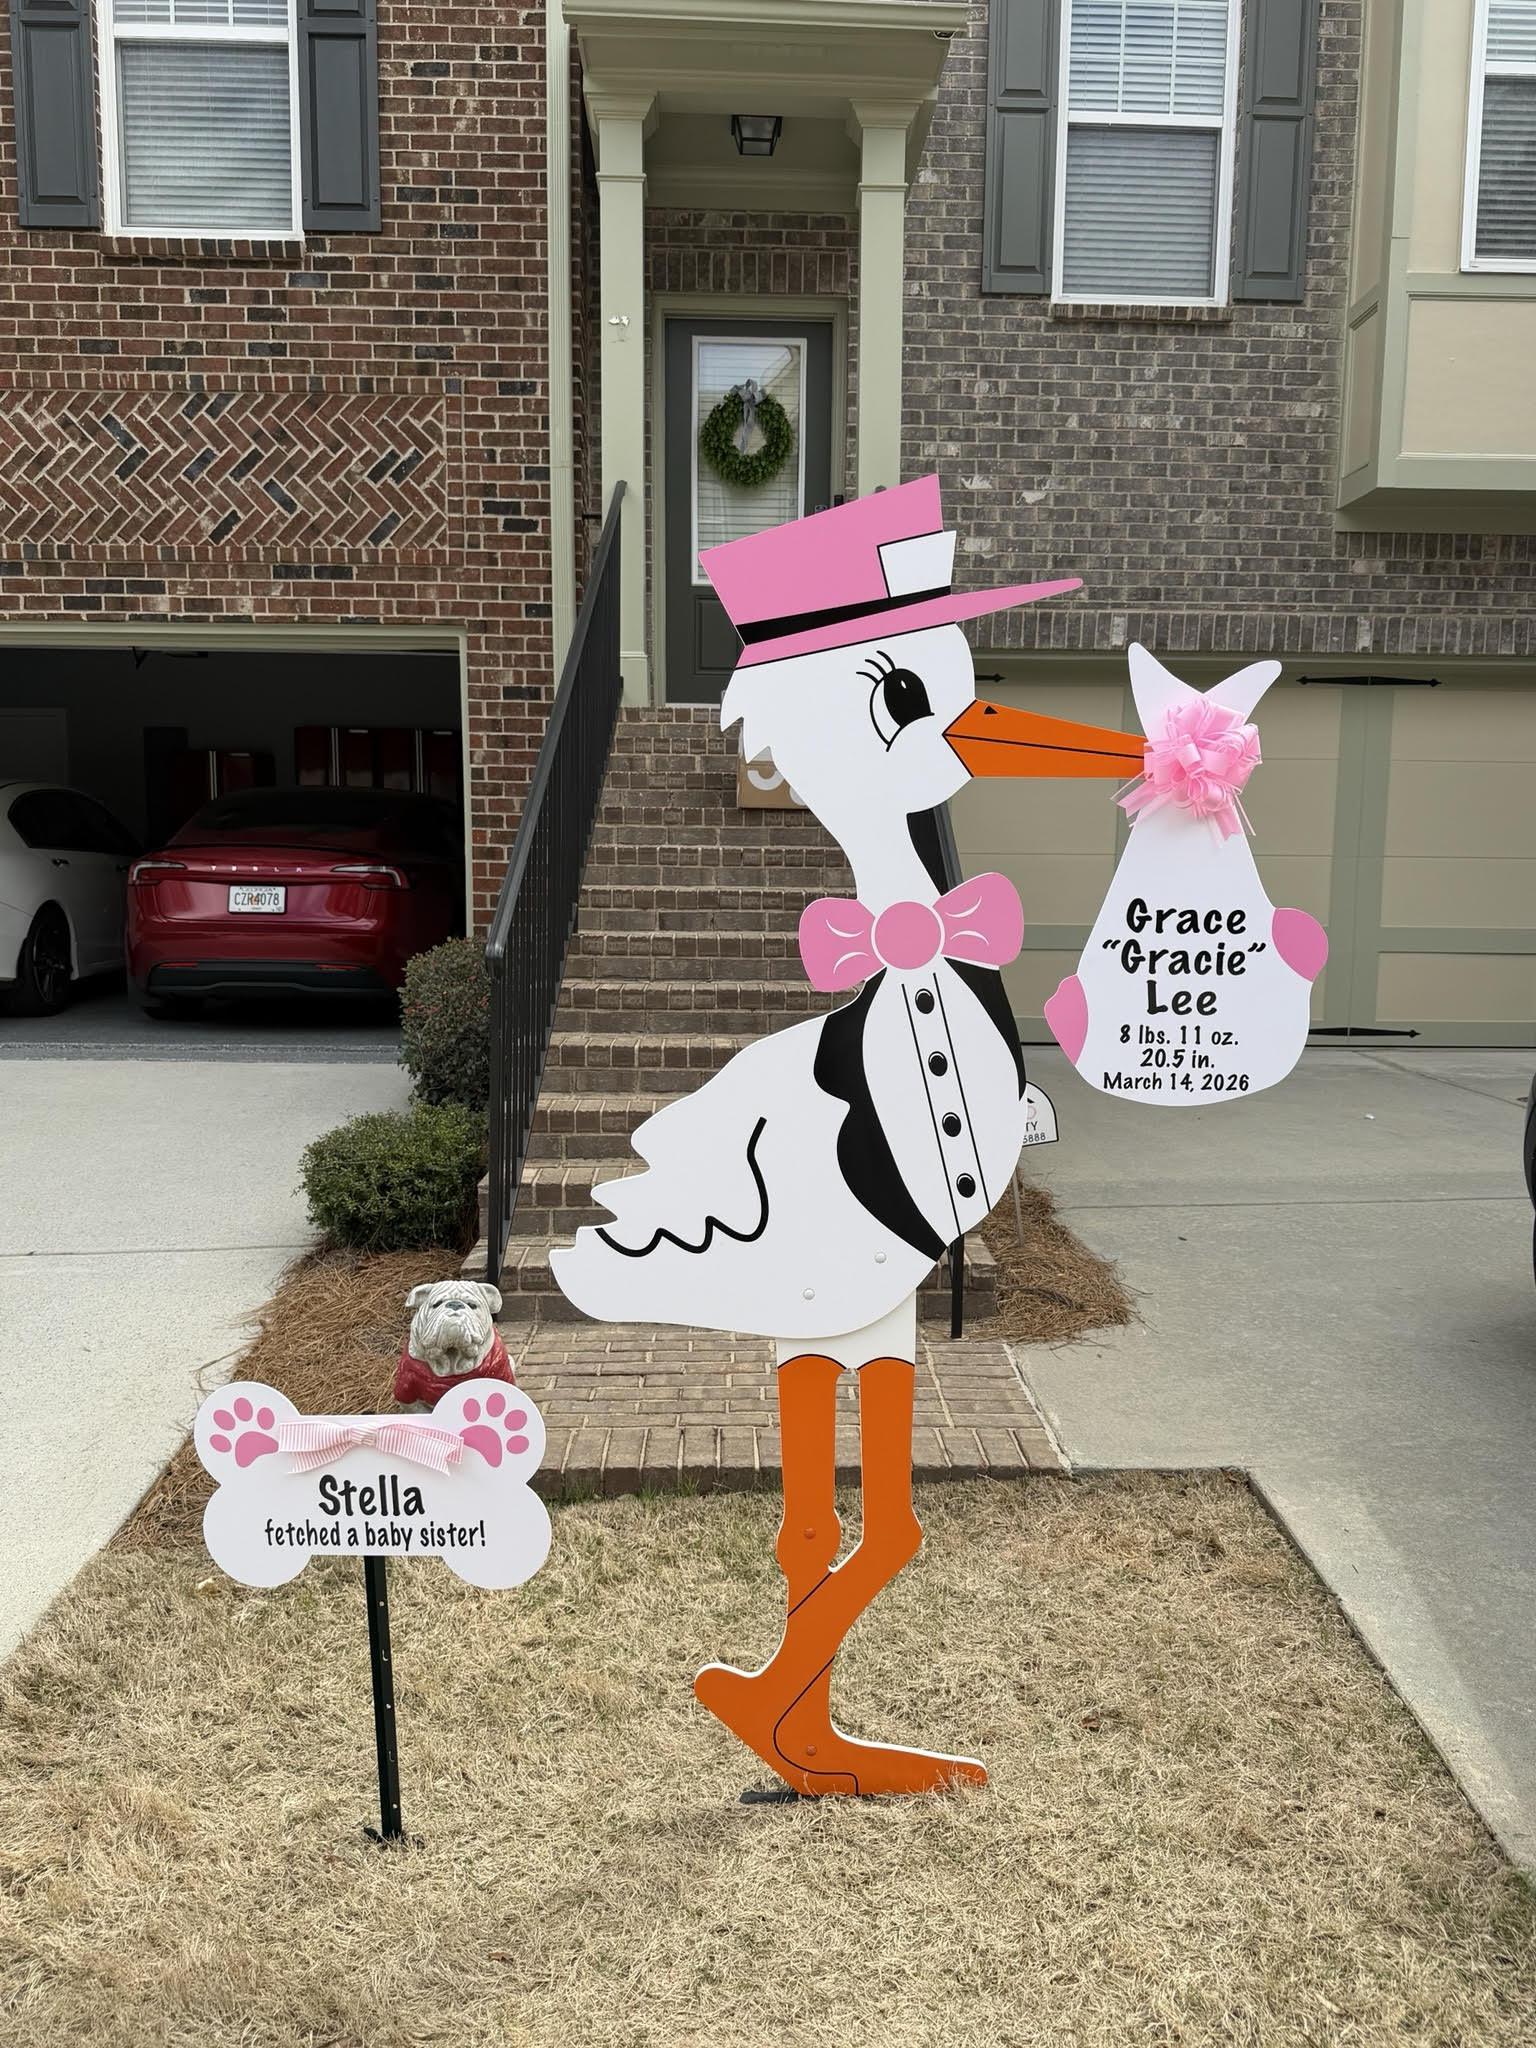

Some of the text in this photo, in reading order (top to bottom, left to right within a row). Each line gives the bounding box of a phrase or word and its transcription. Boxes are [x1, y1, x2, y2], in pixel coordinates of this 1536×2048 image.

[234, 892, 280, 906] CZR4078
[1126, 897, 1247, 934] Grace
[1102, 938, 1267, 976] “Gracie”
[1147, 979, 1218, 1016] Lee
[1119, 1024, 1239, 1046] 8 lbs. 11 oz.
[1140, 1048, 1215, 1069] 20.5 in.
[1103, 1071, 1250, 1092] March 14, 2026
[318, 1474, 426, 1517] Stella
[264, 1518, 486, 1552] fetched a baby sister!
